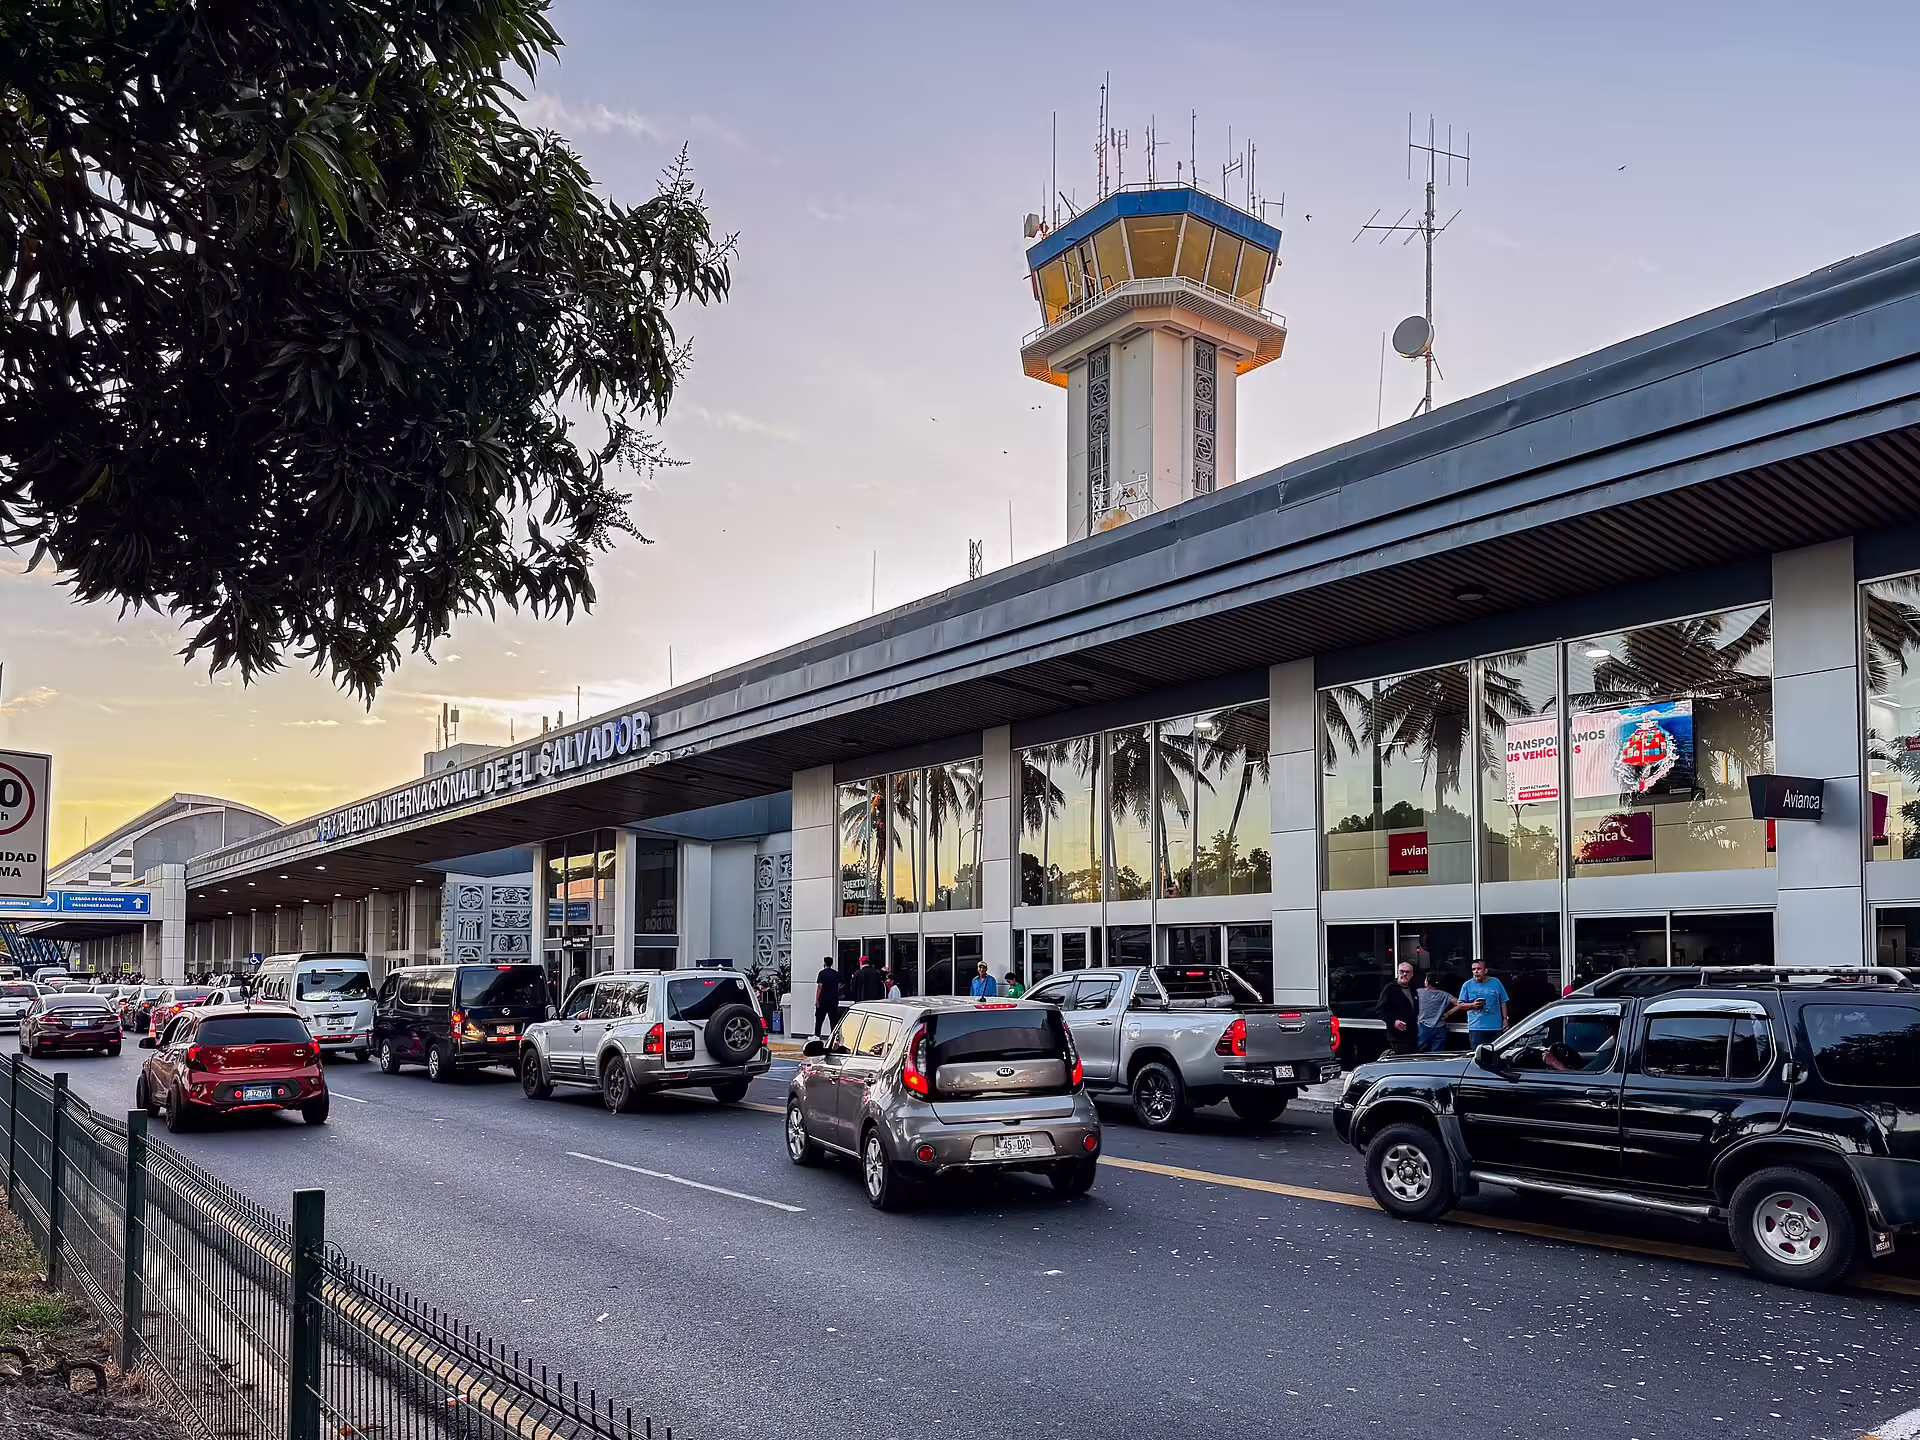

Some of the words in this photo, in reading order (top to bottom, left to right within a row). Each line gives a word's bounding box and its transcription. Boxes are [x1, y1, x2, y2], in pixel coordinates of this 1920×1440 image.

[318, 800, 377, 842] AEROPUERTO
[381, 768, 478, 824] INTERNACIONAL
[484, 757, 507, 794] DE
[511, 751, 532, 786] EL
[540, 711, 651, 777] SALVADOR
[1782, 789, 1821, 809] Avianca
[1401, 845, 1428, 856] avian
